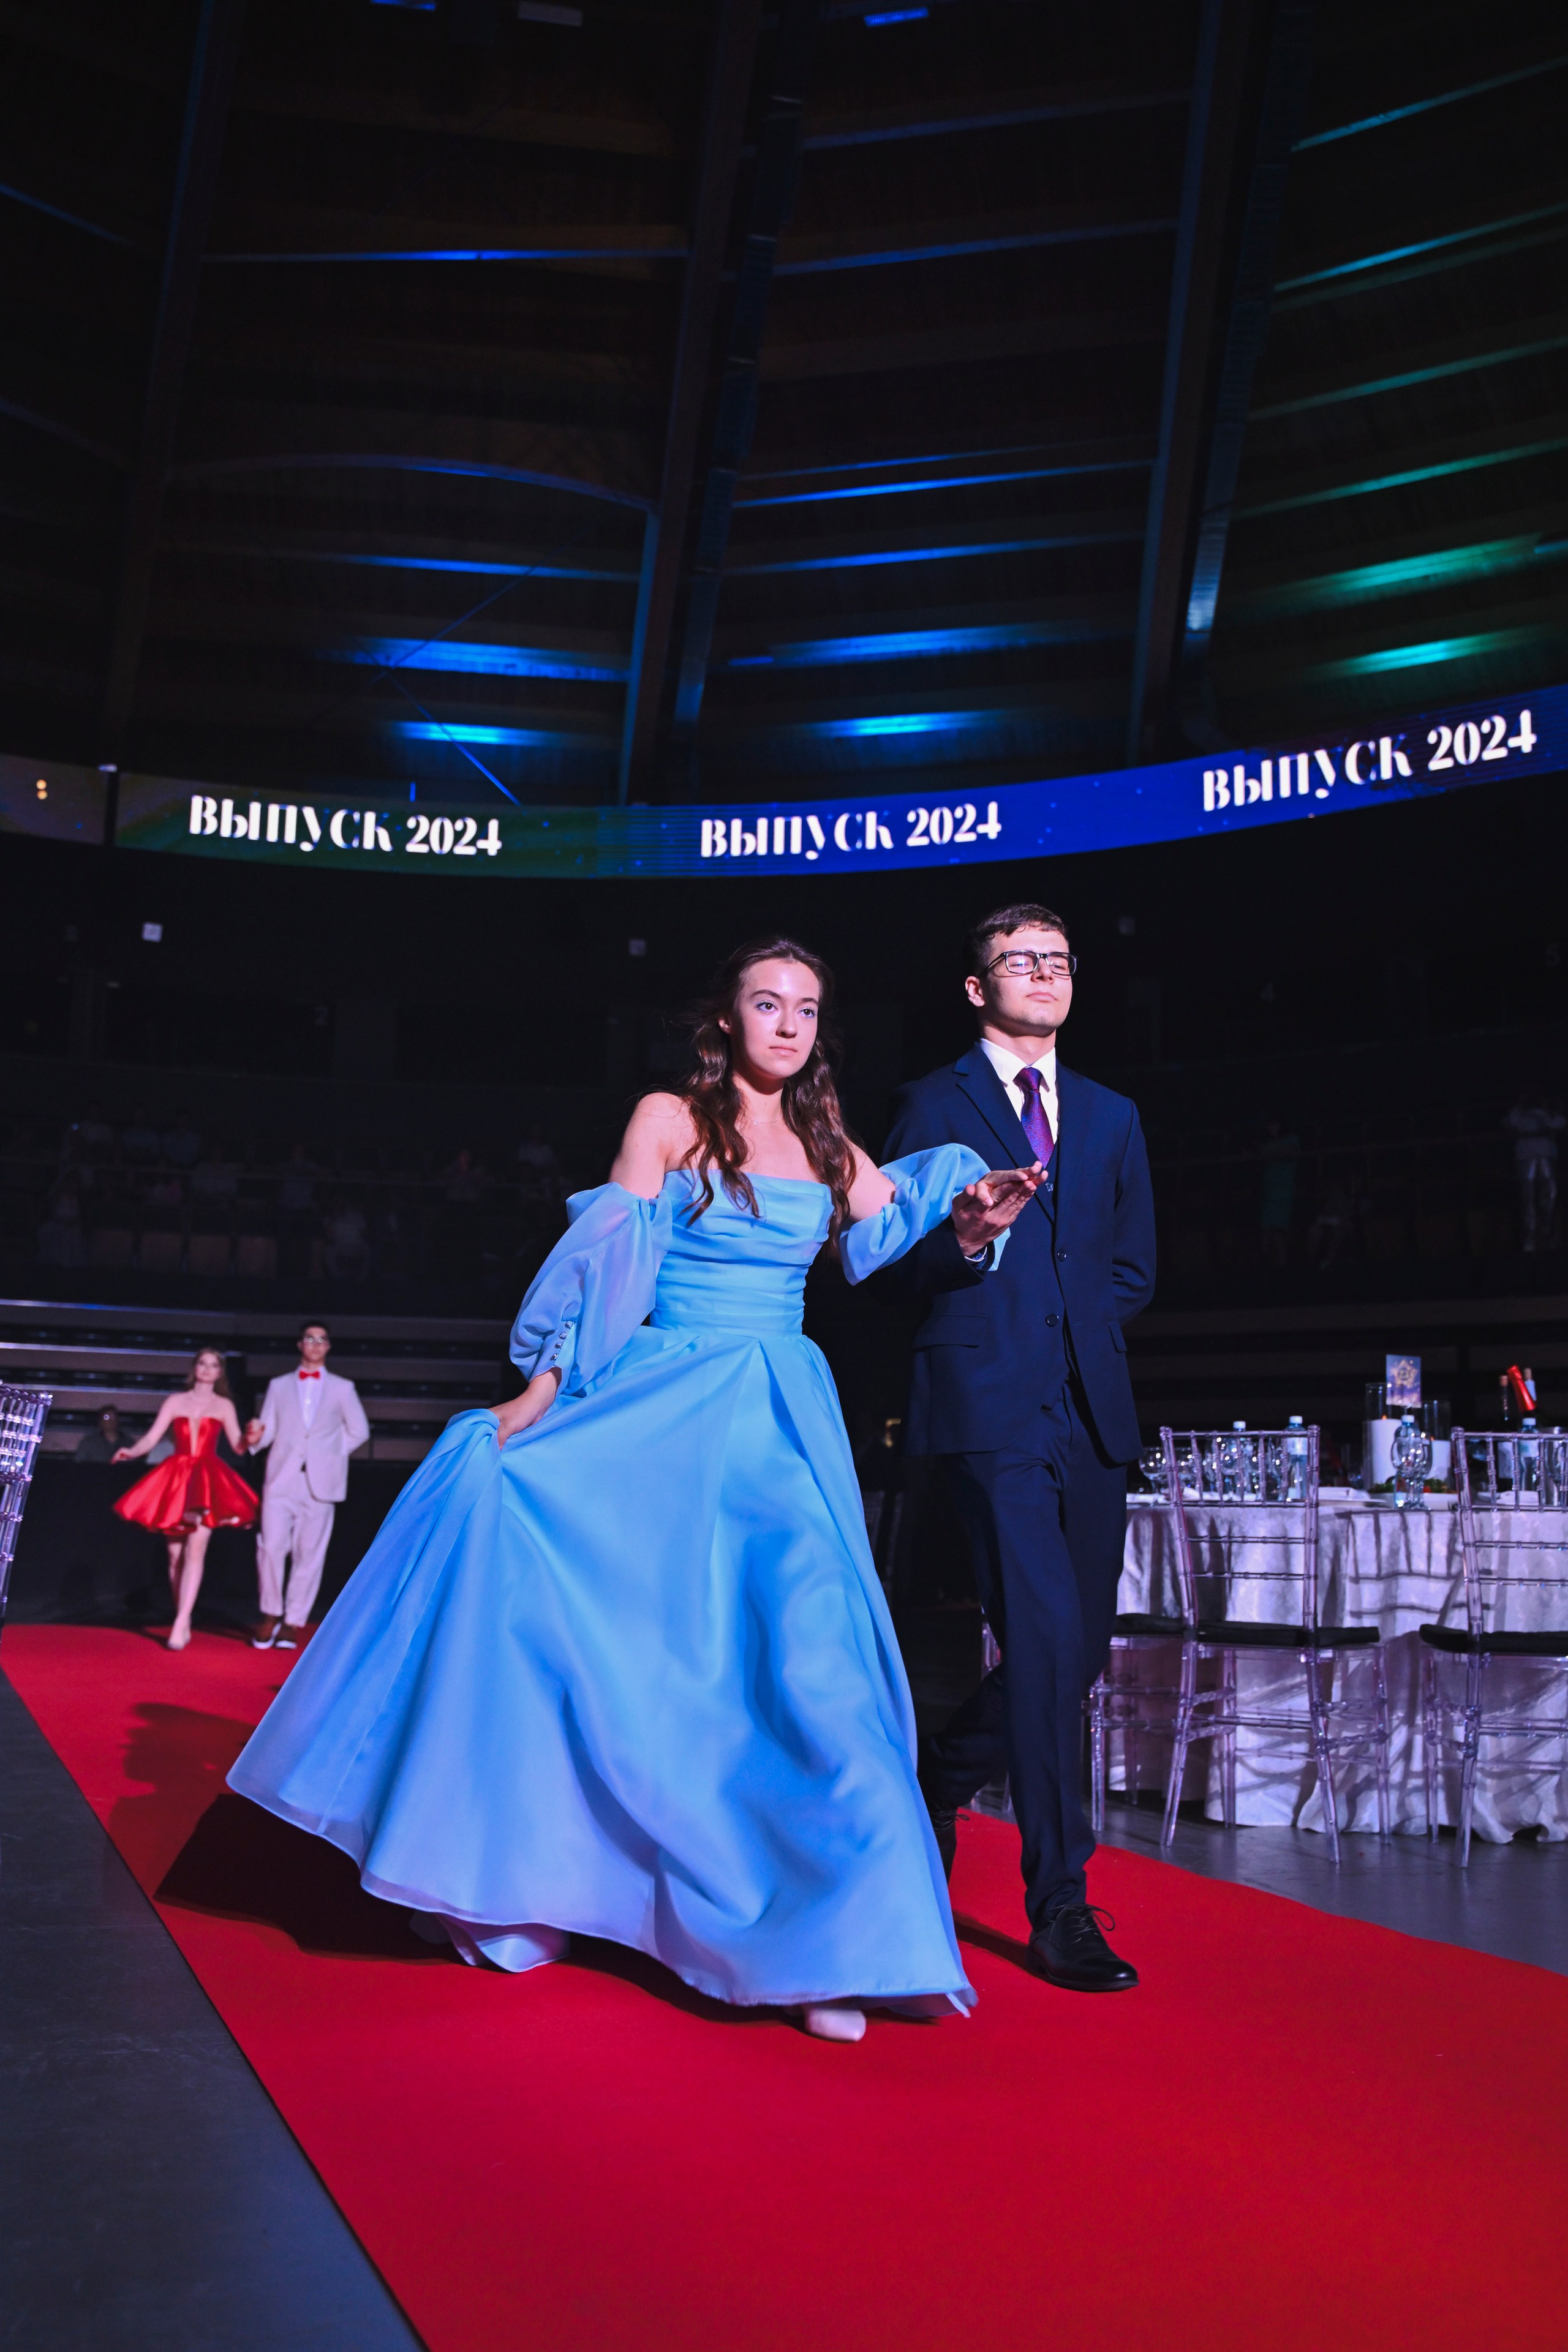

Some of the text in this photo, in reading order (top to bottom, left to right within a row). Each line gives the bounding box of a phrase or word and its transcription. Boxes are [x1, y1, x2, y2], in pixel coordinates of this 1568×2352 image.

[1202, 709, 1538, 812] ВЫПУСК 2024
[189, 794, 503, 857] ВЫПУСК 2024
[700, 801, 1003, 861] ВЫПУСК 2024
